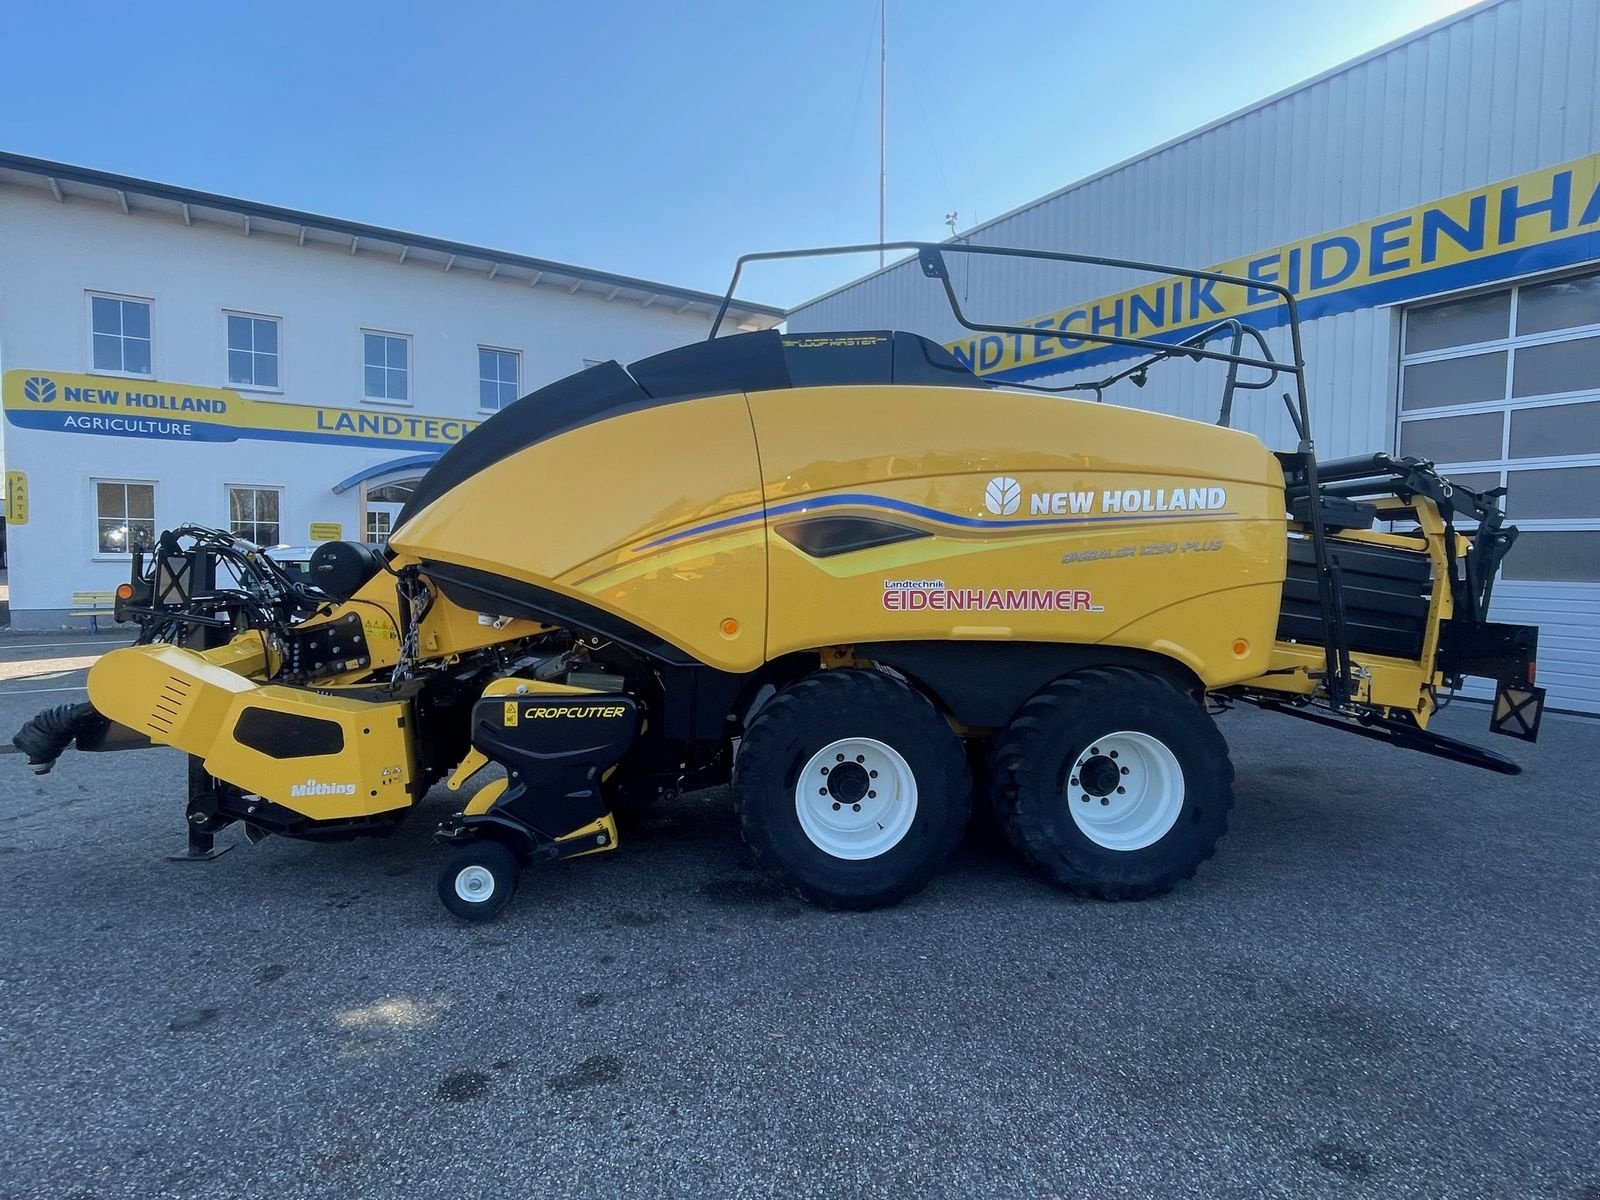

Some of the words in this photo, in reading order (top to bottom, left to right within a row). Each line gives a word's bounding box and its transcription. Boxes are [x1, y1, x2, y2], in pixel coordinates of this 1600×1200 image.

[64, 387, 119, 405] NEW
[125, 392, 227, 414] HOLLAND
[64, 415, 191, 436] AGRICULTURE
[16, 476, 24, 520] PARTS
[1030, 491, 1095, 515] NEW
[1102, 487, 1226, 513] HOLLAND
[1061, 547, 1136, 564] BIGBALER
[1181, 539, 1224, 553] PLUS
[884, 580, 944, 589] Landtechnik
[883, 590, 1091, 610] EIDENHAMMER
[525, 707, 625, 719] CROPCUTTER
